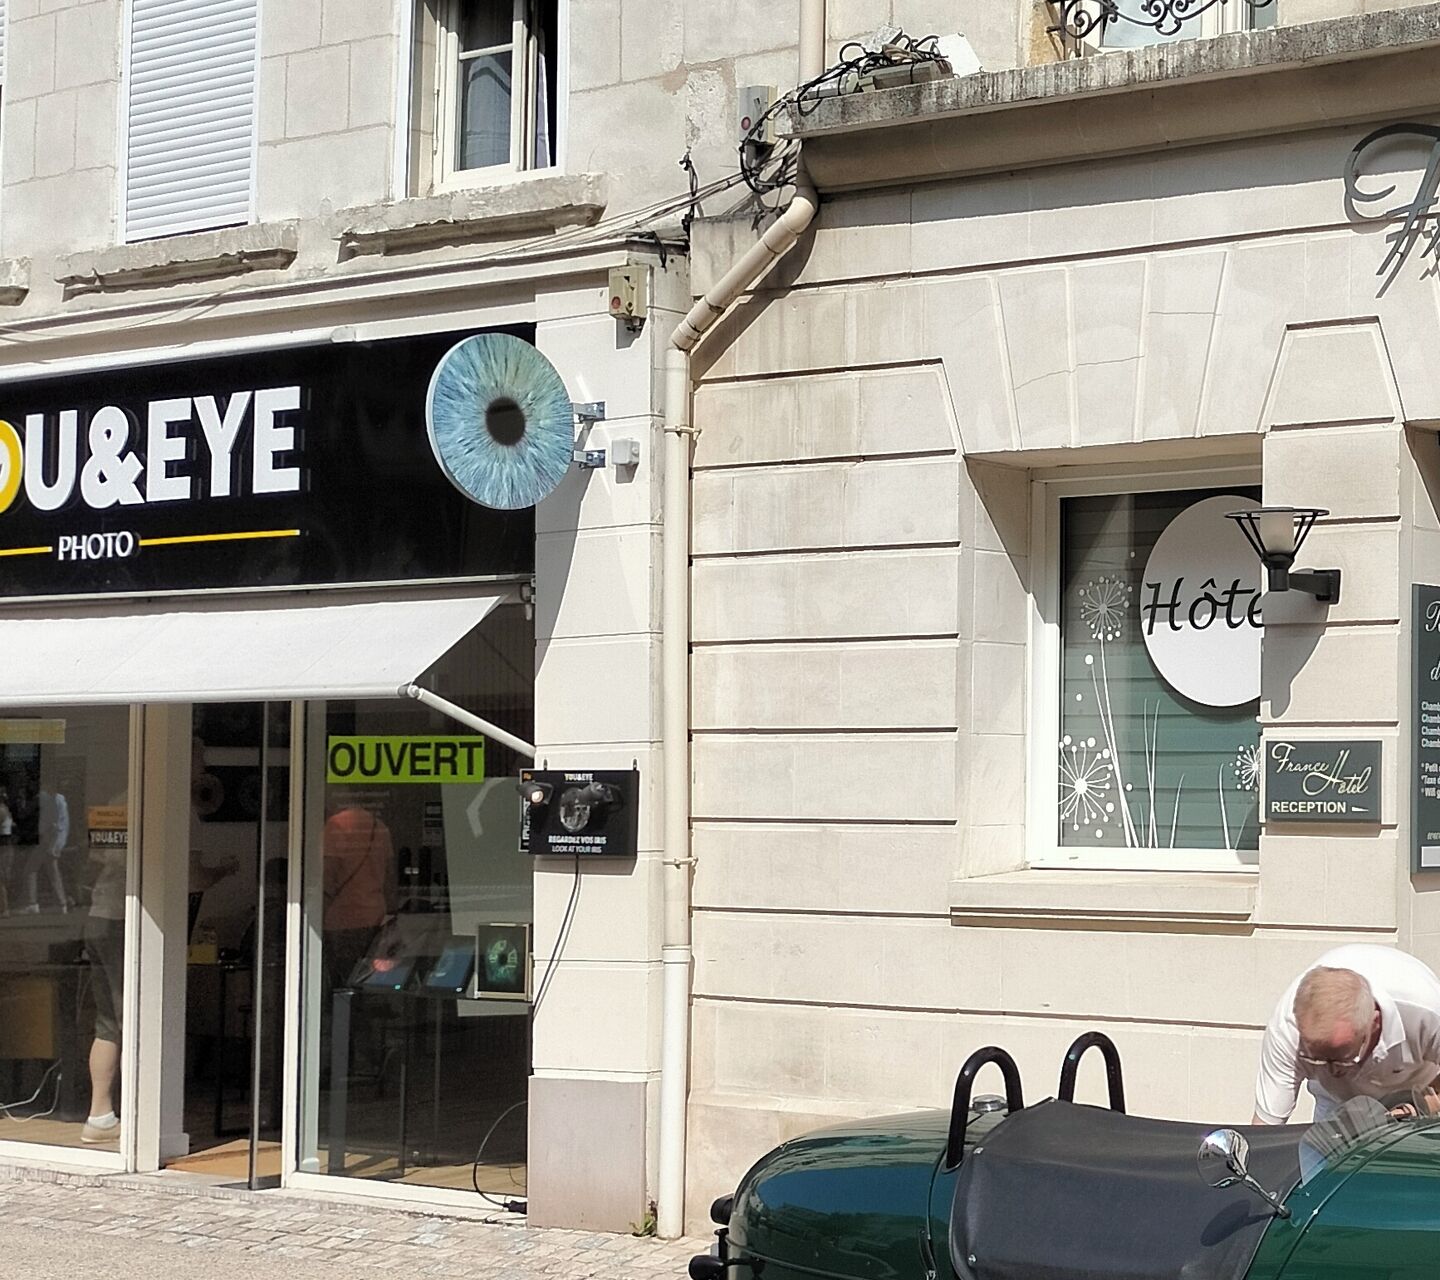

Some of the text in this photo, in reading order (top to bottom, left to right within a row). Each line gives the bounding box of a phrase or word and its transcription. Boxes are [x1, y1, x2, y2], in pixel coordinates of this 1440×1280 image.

[58, 531, 134, 561] PHOTO
[329, 741, 483, 777] OUVERT
[1271, 742, 1330, 774] France
[1271, 801, 1347, 813] RECEPTION
